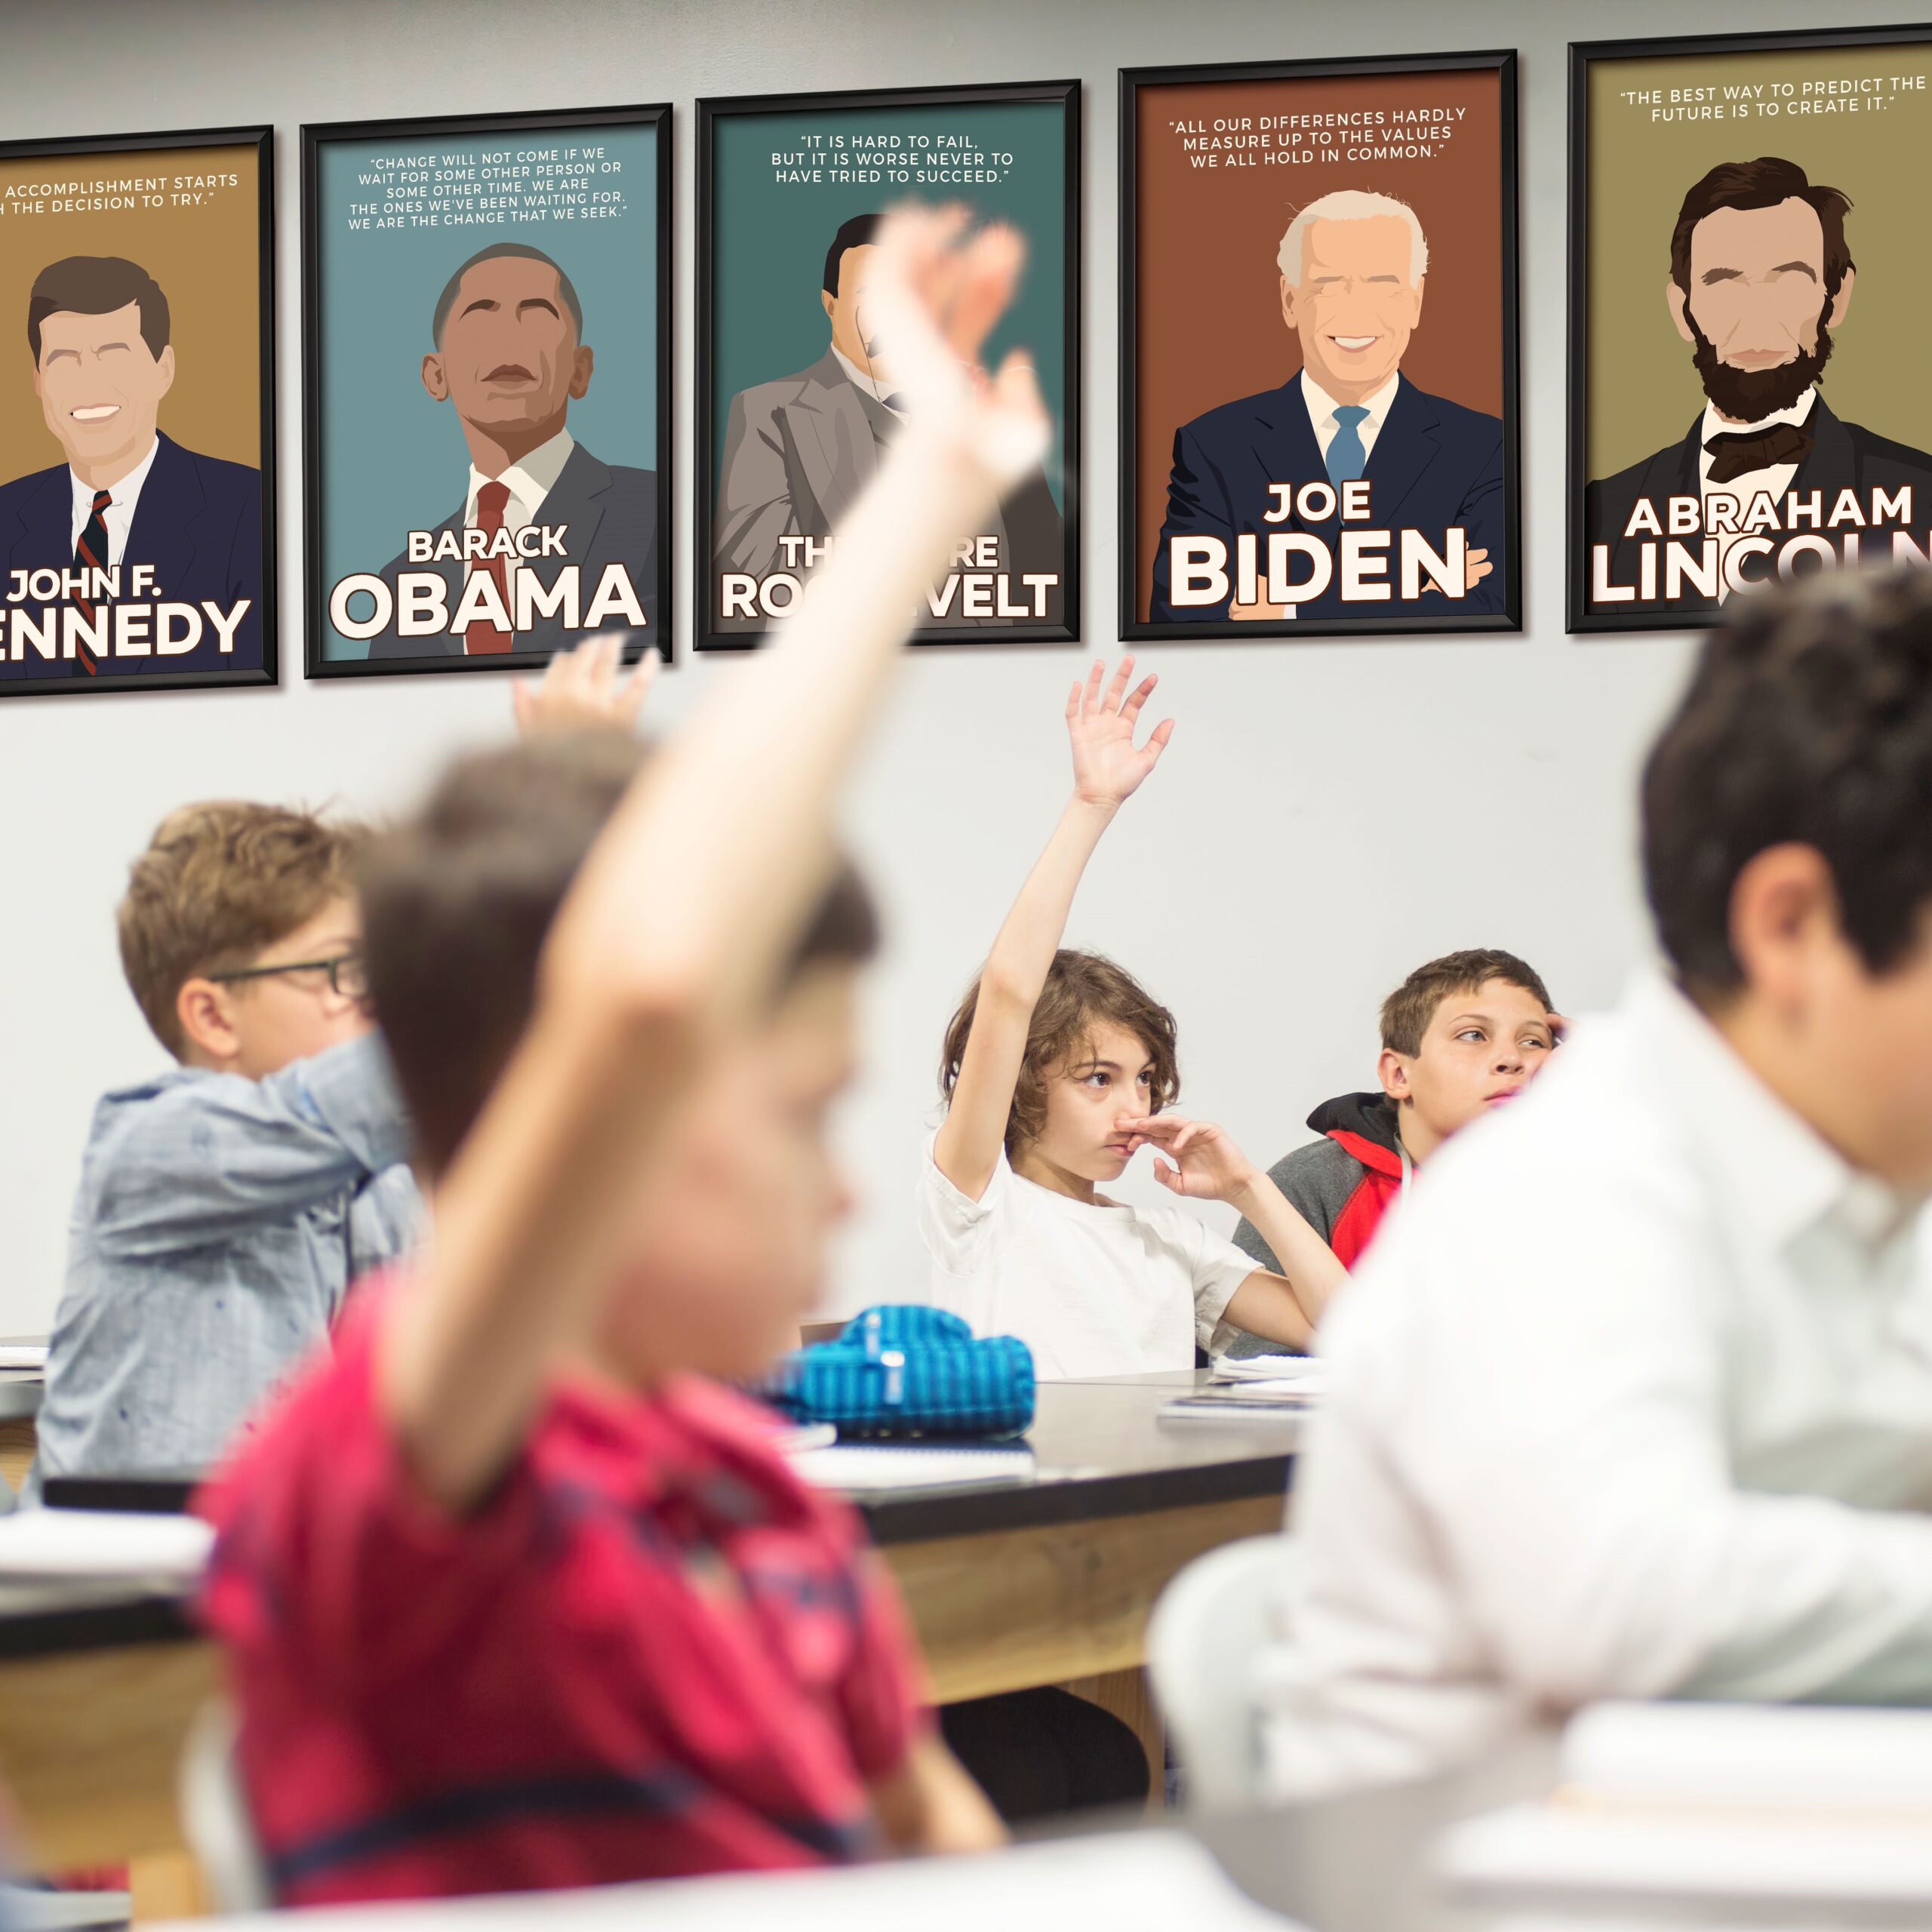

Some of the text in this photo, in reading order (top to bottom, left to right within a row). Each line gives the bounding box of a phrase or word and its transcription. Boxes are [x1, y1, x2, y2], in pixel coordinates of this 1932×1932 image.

[1620, 76, 1926, 105] “THE BEST WAY TO PREDICT THE
[1169, 107, 1466, 134] “ALL OUR DIFFERENCES HARDLY
[1652, 96, 1895, 122] FUTURE IS TO CREATE IT.”
[801, 136, 978, 149] “IT IS HARD TO FAIL,
[1183, 126, 1451, 151] MEASURE UP TO THE VALUES
[371, 148, 605, 170] “CHANGE WILL NOT COME IF WE
[772, 153, 1014, 165] BUT IT IS WORSE NEVER TO
[1191, 144, 1444, 168] WE ALL HOLD IN COMMON.”
[5, 174, 238, 198] ACCOMPLISHMENT STARTS
[358, 162, 621, 185] WAIT FOR SOME OTHER PERSON OR
[776, 171, 1009, 183] HAVE TRIED TO SUCCEED.”
[386, 178, 589, 198] SOME OTHER TIME. WE ARE
[12, 202, 44, 214] THE
[52, 196, 134, 213] DECISION
[142, 195, 164, 208] TO
[171, 192, 214, 205] TRY.”
[350, 192, 625, 215] THE ONES WE'VE BEEN WAITING FOR.
[349, 206, 627, 230] WE ARE THE CHANGE THAT WE SEEK.”
[1263, 481, 1371, 522] JOE
[1624, 486, 1912, 537] ABRAHAM
[408, 525, 568, 562] BARACK
[778, 535, 998, 568] THRE
[1171, 528, 1466, 606] BIDEN
[6, 565, 162, 601] JOHN F.
[721, 573, 1059, 617] ROVELT
[330, 564, 647, 639] OBAMA
[0, 600, 251, 661] NNEDY
